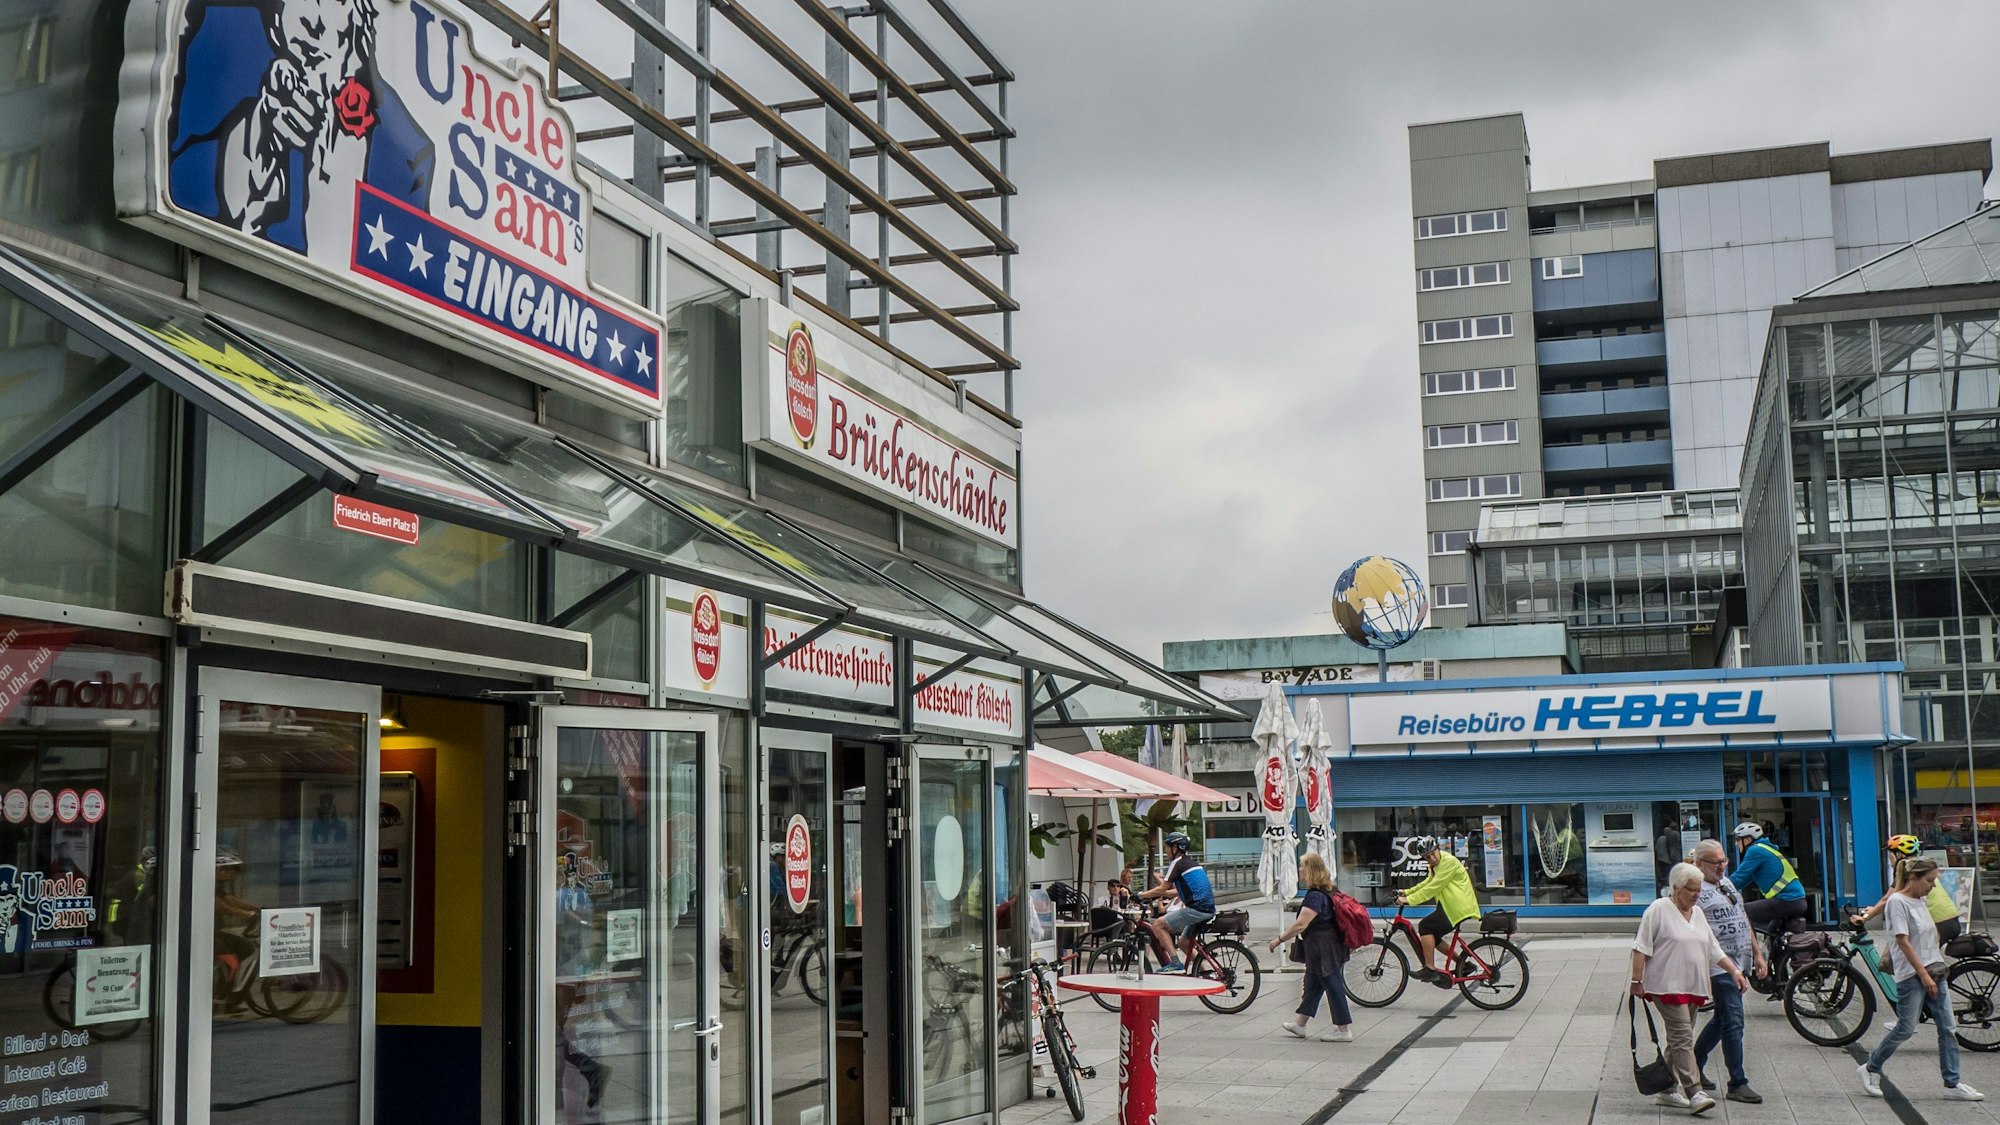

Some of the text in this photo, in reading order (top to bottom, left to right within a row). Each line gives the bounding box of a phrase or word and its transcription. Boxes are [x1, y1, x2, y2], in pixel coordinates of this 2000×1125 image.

[410, 4, 564, 170] Uncle
[448, 122, 583, 267] Sam's
[444, 240, 598, 361] EINGANG
[792, 396, 812, 424] Kölsch
[828, 395, 1007, 535] Brückenschänke
[337, 503, 417, 533] Friedrich Ebert Platz 9
[7, 671, 29, 695] Uhr
[28, 646, 52, 673] früh
[916, 672, 1012, 731] Reissdorf Kölsch
[1398, 689, 1777, 736] Reisebüro HEBBEL
[21, 872, 86, 904] Uncle
[37, 897, 97, 929] Sam's
[53, 940, 75, 948] DRINKS
[81, 938, 93, 946] FUN
[97, 968, 130, 977] Benutzung
[100, 956, 128, 965] Toiletten-
[4, 1032, 46, 1055] Billard
[61, 1029, 89, 1048] Dart
[4, 1055, 87, 1084] Internet Café
[42, 1081, 108, 1106] Restaurant
